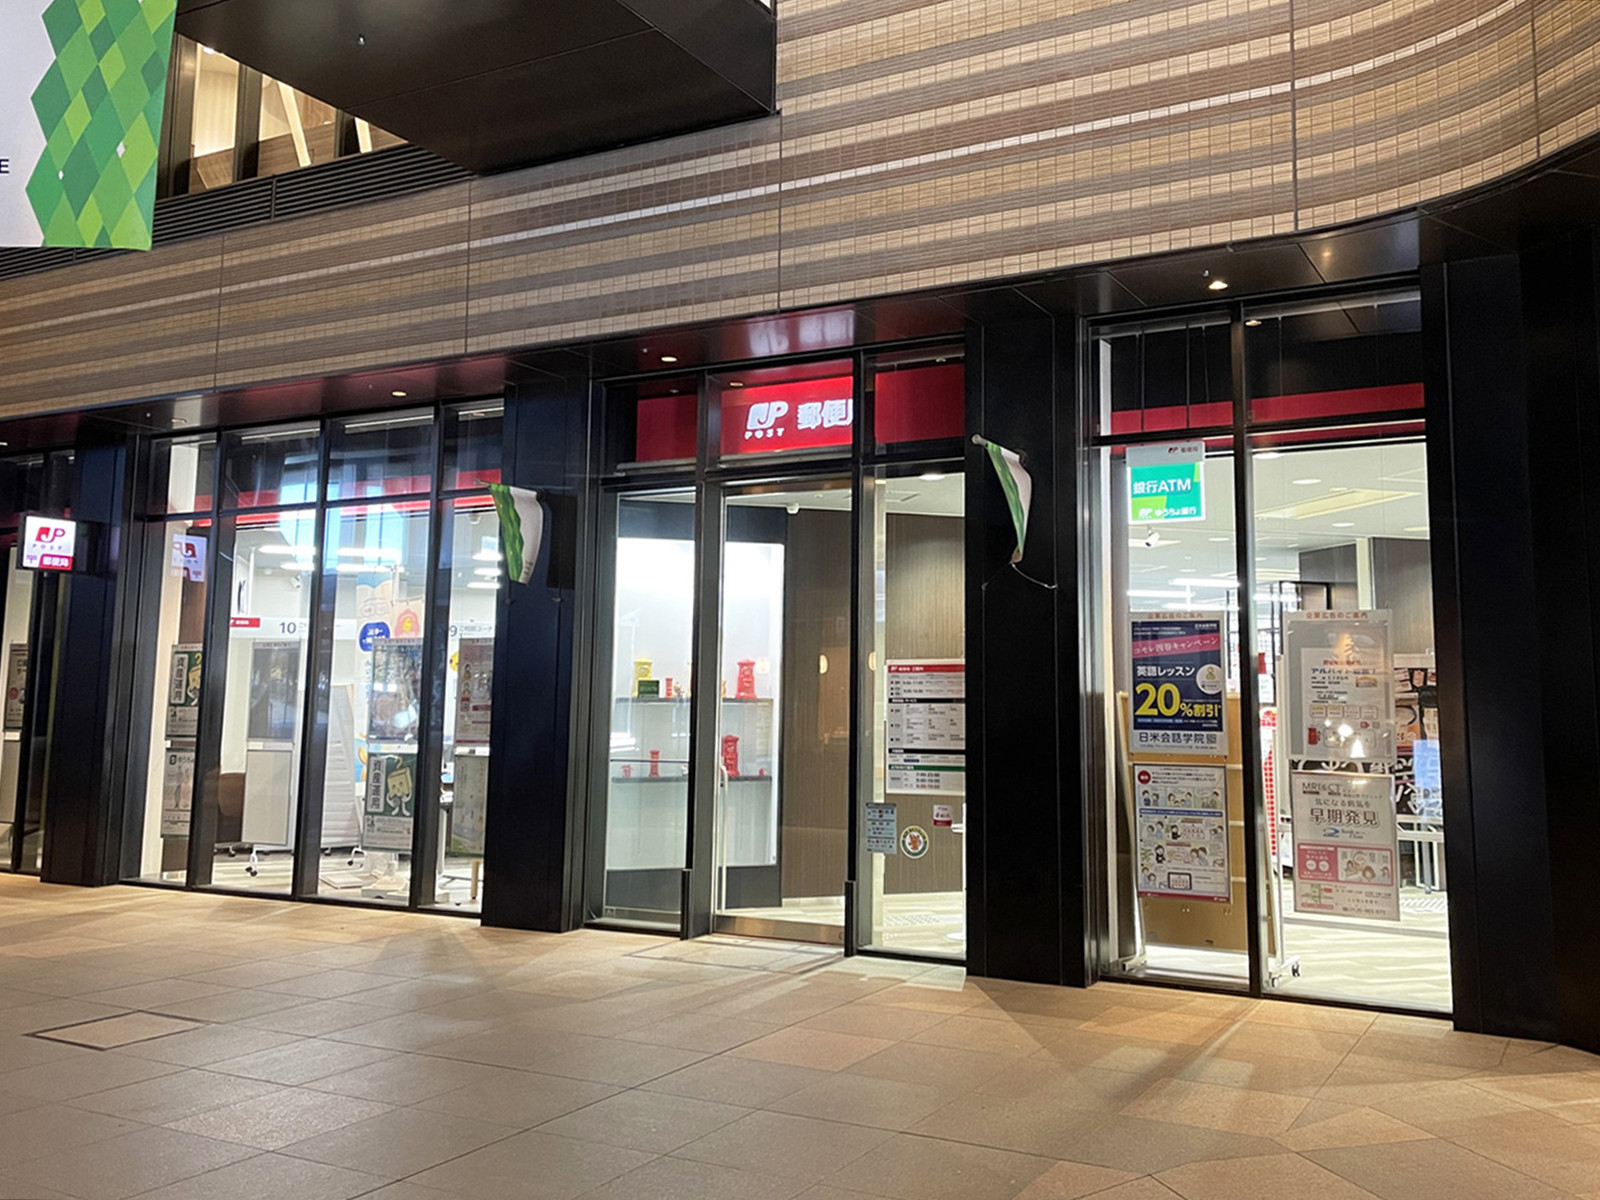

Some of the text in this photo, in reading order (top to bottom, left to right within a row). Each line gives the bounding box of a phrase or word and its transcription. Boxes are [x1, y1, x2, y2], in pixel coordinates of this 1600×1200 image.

[797, 398, 853, 430] 郵便
[744, 427, 785, 440] POST
[1133, 478, 1192, 494] 銀行ATM
[1154, 506, 1197, 517] ゆうちょ銀行
[35, 526, 66, 543] JP
[280, 622, 297, 634] 10
[1133, 636, 1219, 654] コモレ四谷キャンペーン
[1137, 663, 1196, 677] 英語レッスン
[1139, 732, 1205, 744] 日米会話学院
[1310, 807, 1378, 826] 早期発見
